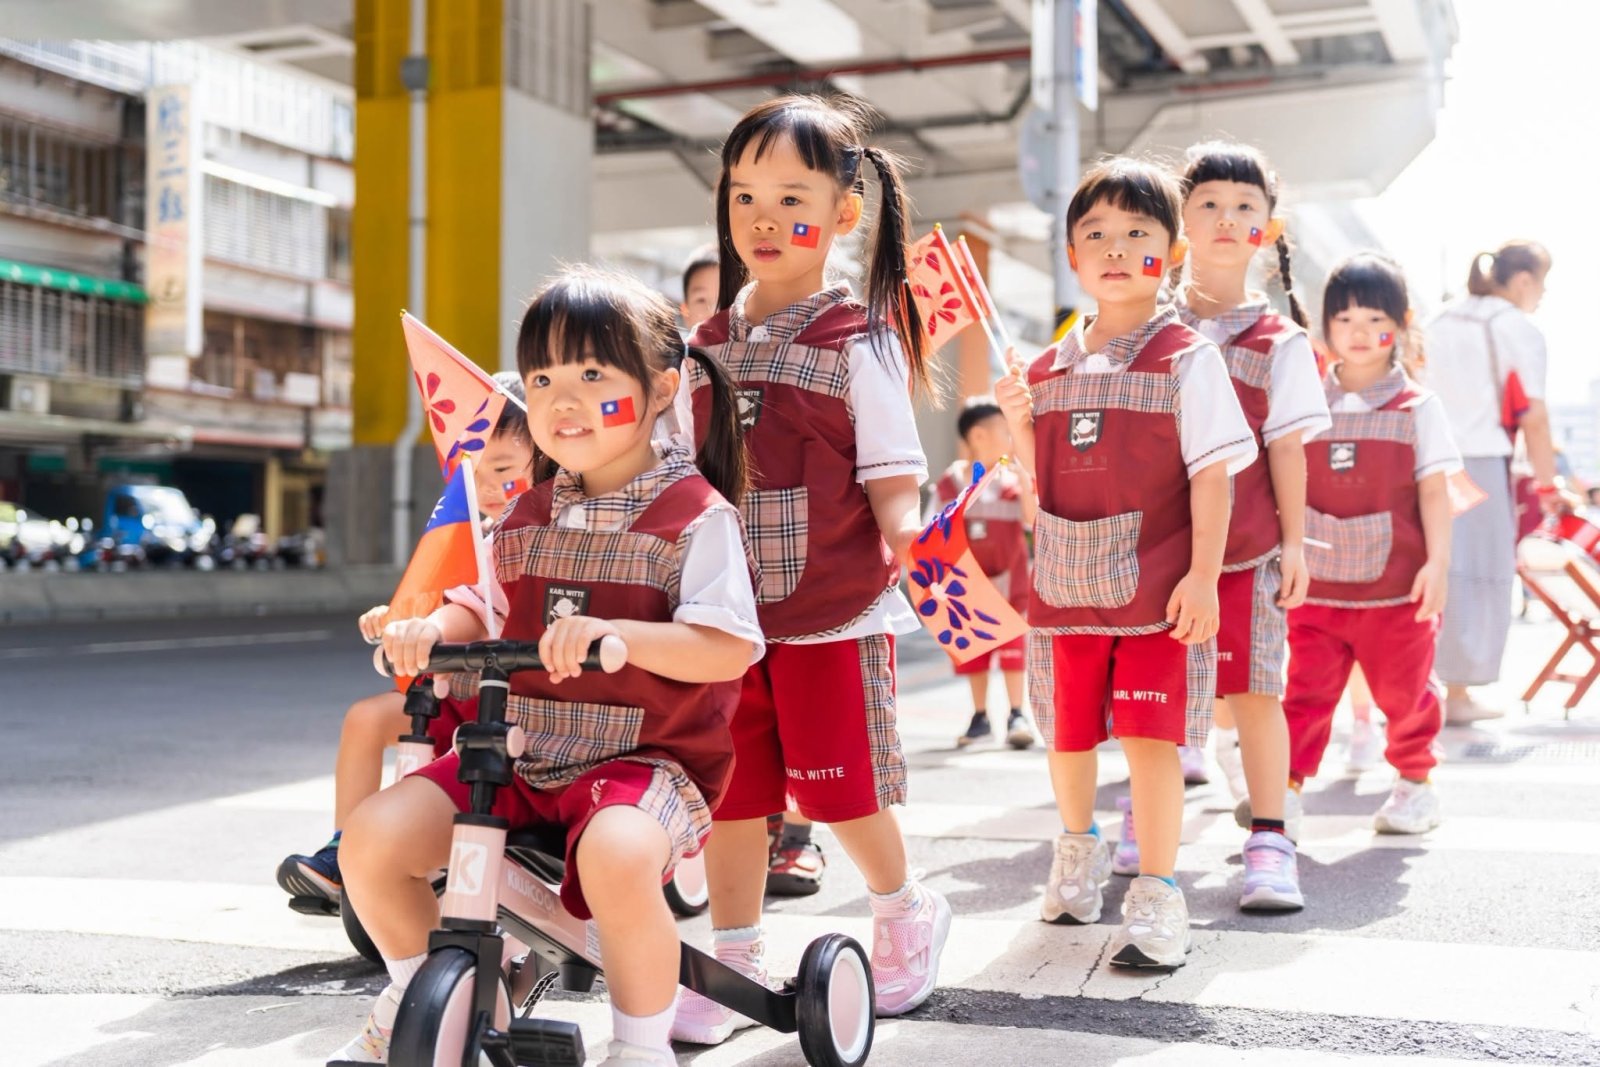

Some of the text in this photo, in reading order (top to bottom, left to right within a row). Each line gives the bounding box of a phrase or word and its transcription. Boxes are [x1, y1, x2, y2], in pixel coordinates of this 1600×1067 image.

[549, 587, 585, 598] KARL WITTE
[1132, 689, 1168, 704] WITTE
[806, 766, 845, 781] WITTE
